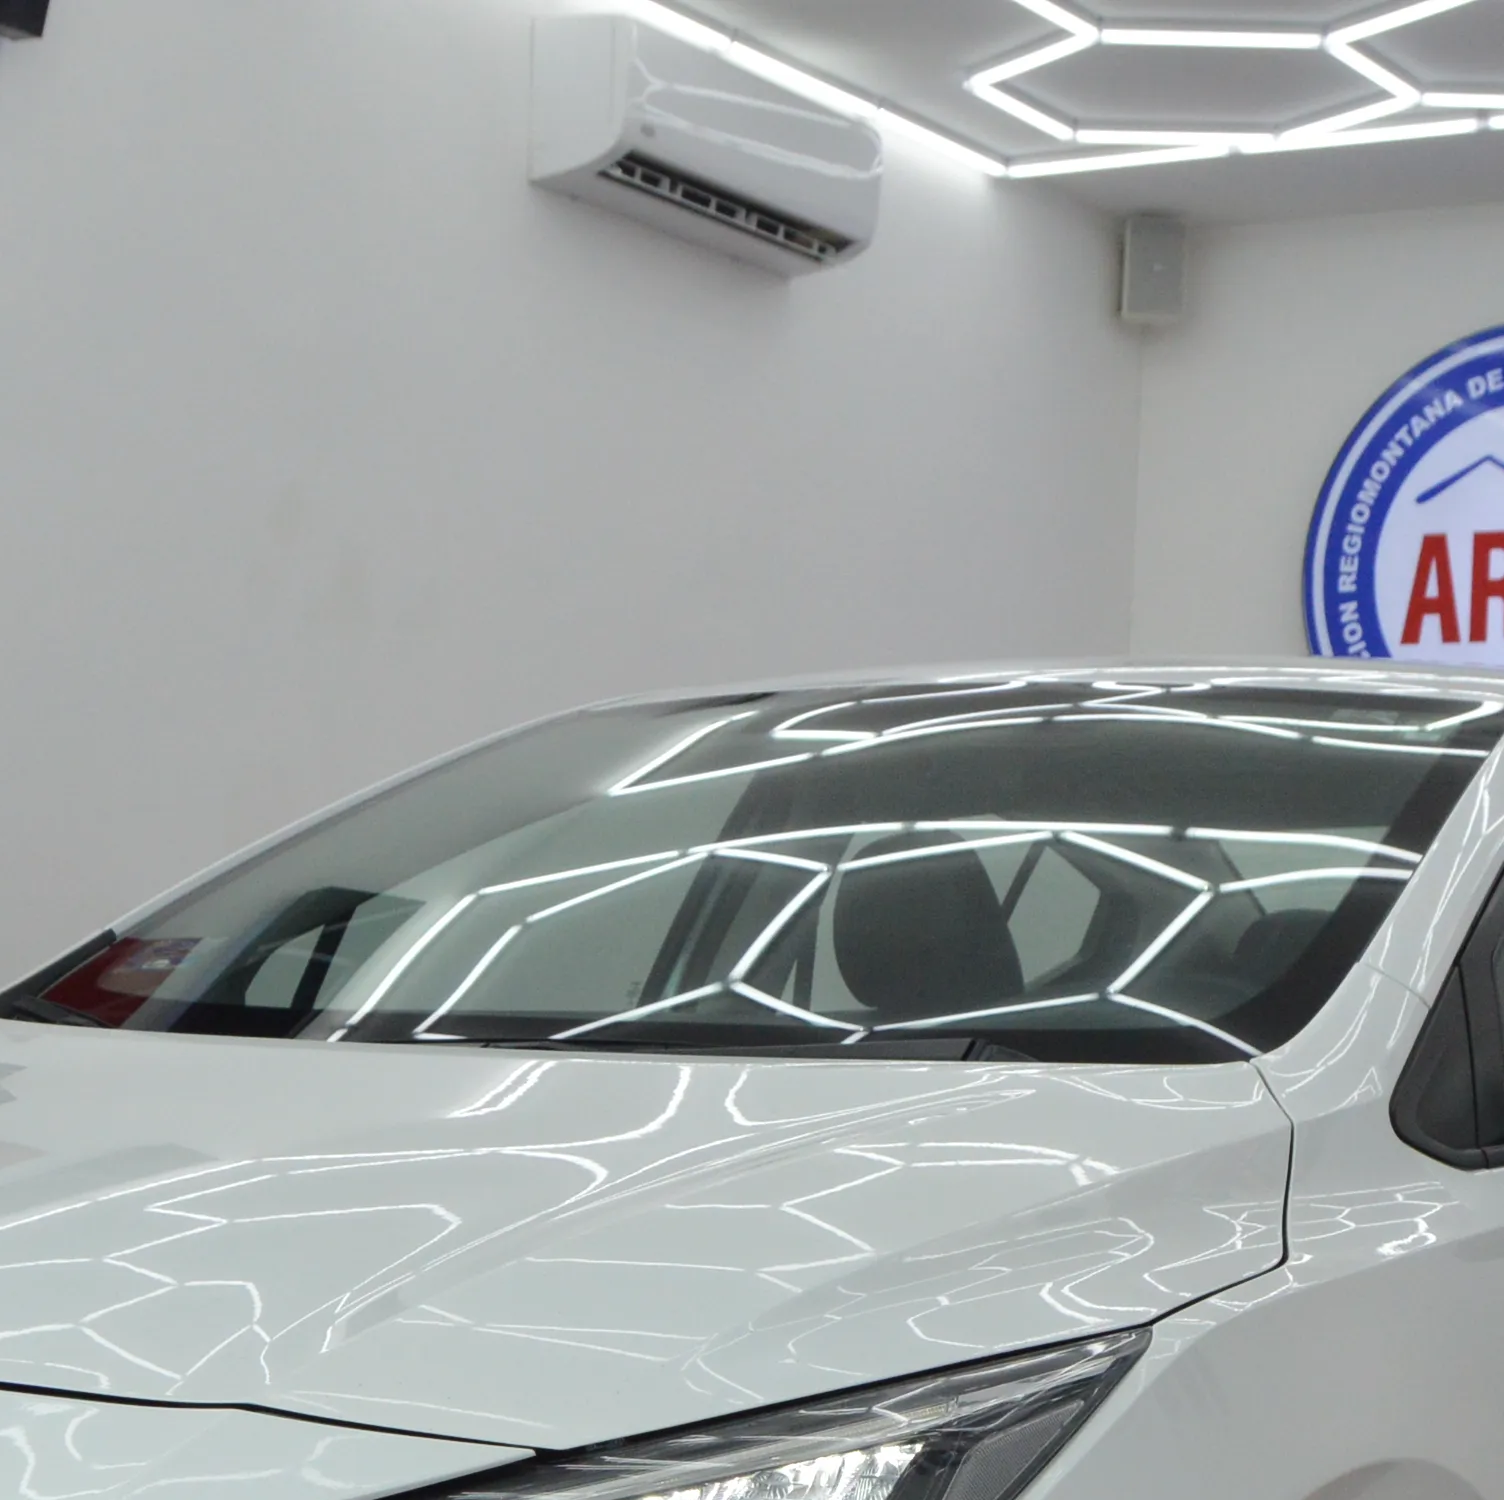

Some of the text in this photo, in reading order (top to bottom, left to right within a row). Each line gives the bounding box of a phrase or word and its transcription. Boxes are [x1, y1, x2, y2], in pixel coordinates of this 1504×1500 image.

[1466, 368, 1504, 399] DE
[1337, 389, 1464, 594] REGIOMONTANA
[1338, 600, 1372, 659] ION
